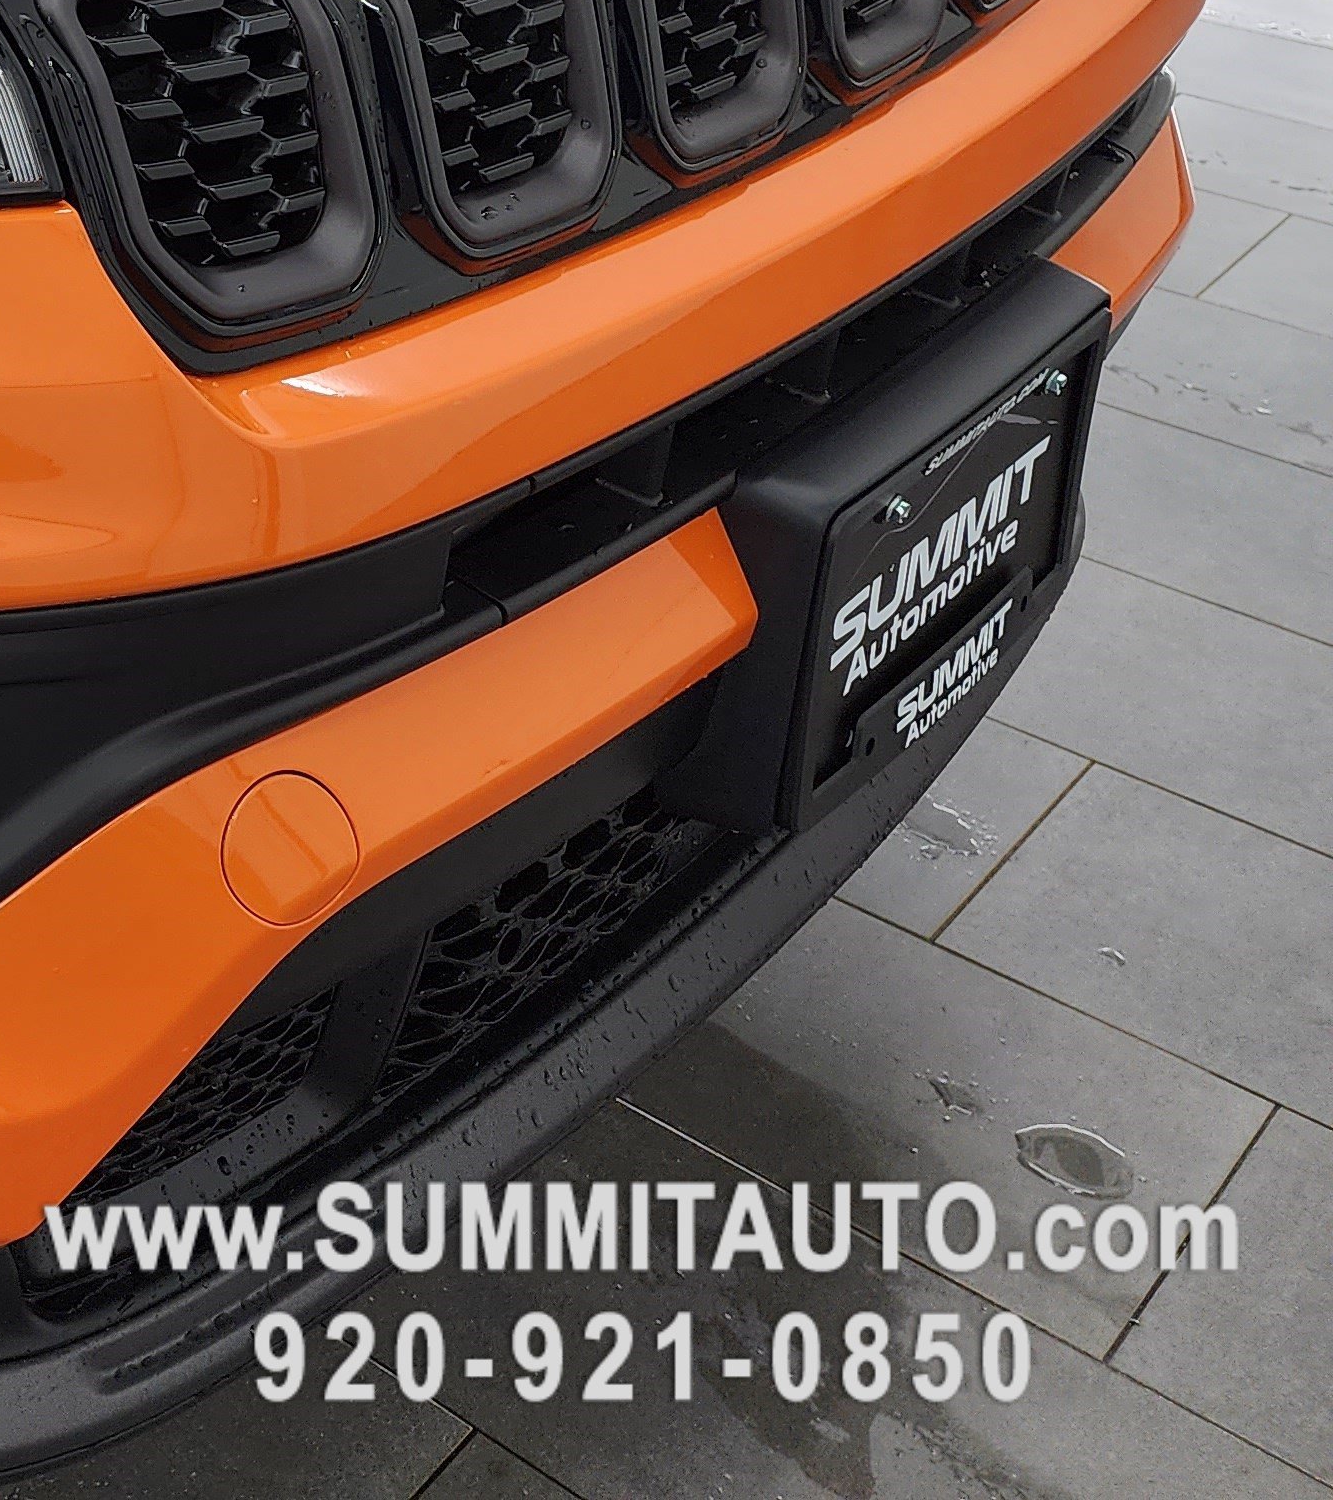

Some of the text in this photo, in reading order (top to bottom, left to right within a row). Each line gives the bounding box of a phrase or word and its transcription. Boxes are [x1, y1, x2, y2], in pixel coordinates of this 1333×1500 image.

[829, 433, 1052, 672] SUMMIT
[842, 518, 1020, 697] Automotive
[895, 596, 1014, 734] SUMMIT
[903, 647, 1001, 750] Automotive
